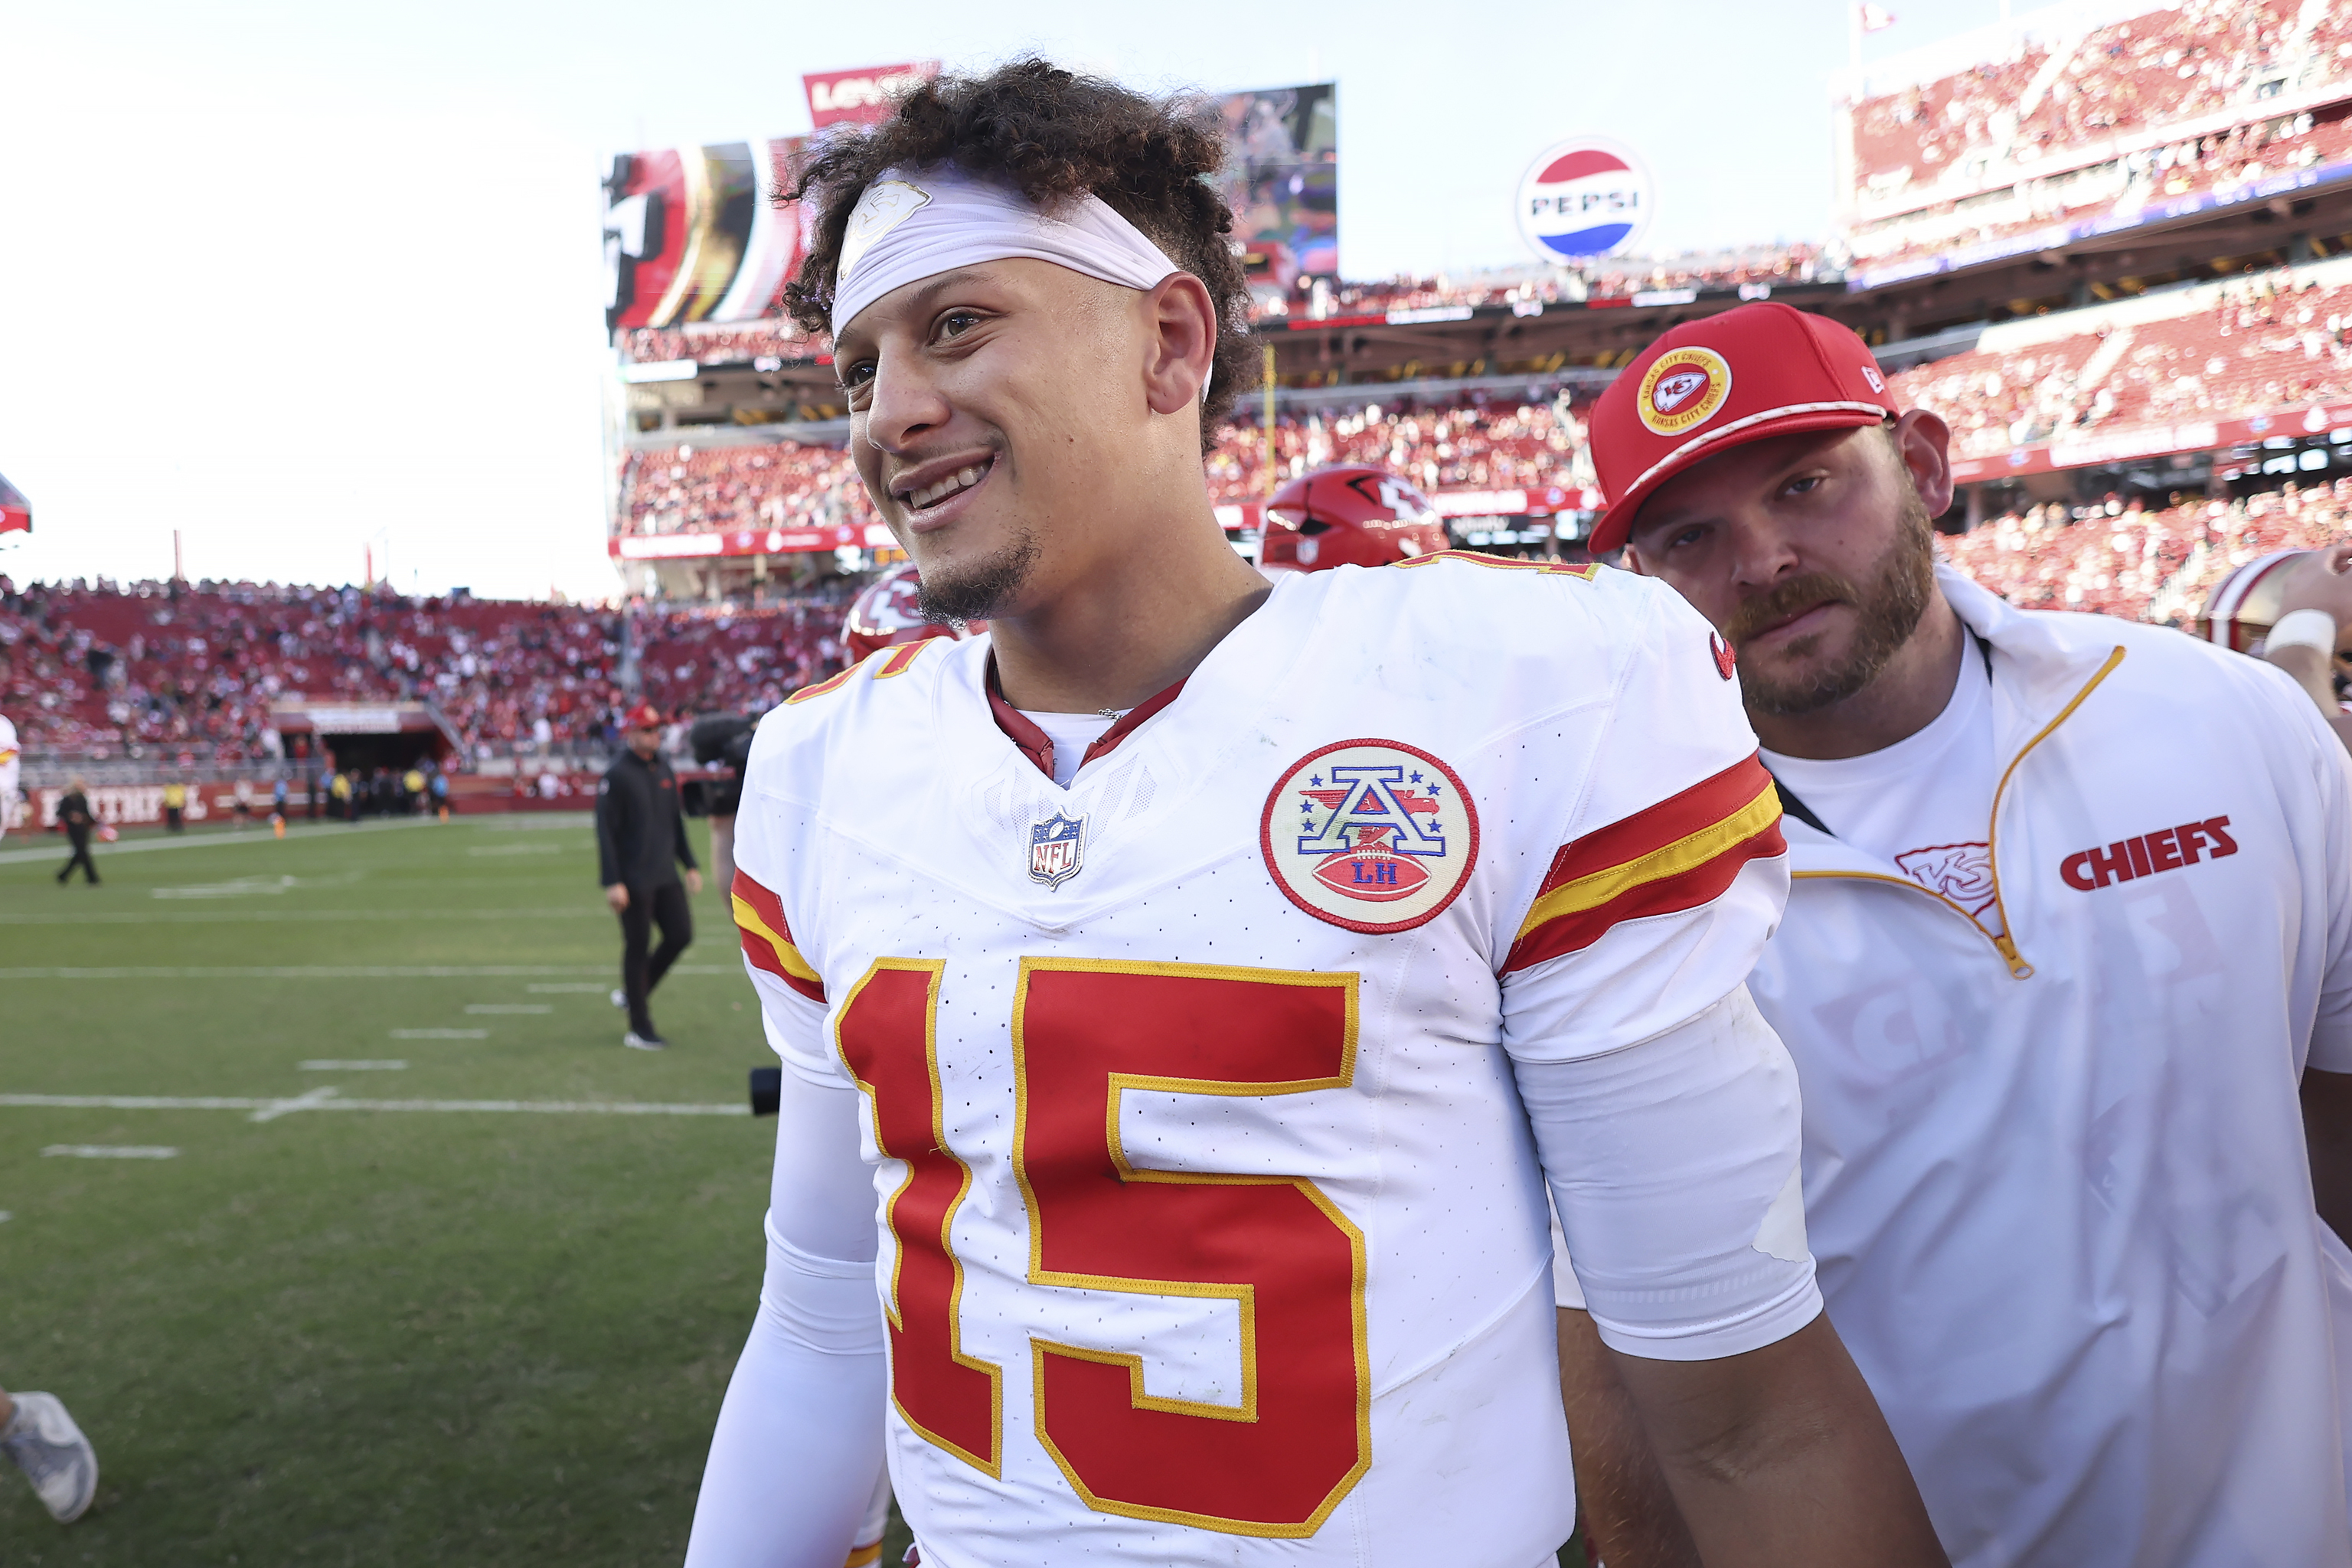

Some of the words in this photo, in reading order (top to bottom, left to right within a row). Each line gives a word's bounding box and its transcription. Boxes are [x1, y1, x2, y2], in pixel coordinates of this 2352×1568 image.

[1532, 191, 1638, 215] PEPSI
[1681, 408, 1700, 424] CITY
[1298, 766, 1446, 857] A
[1034, 841, 1072, 874] NFL
[2059, 814, 2239, 893] CHIEFS
[1351, 862, 1398, 884] LH
[835, 956, 1372, 1539] 15
